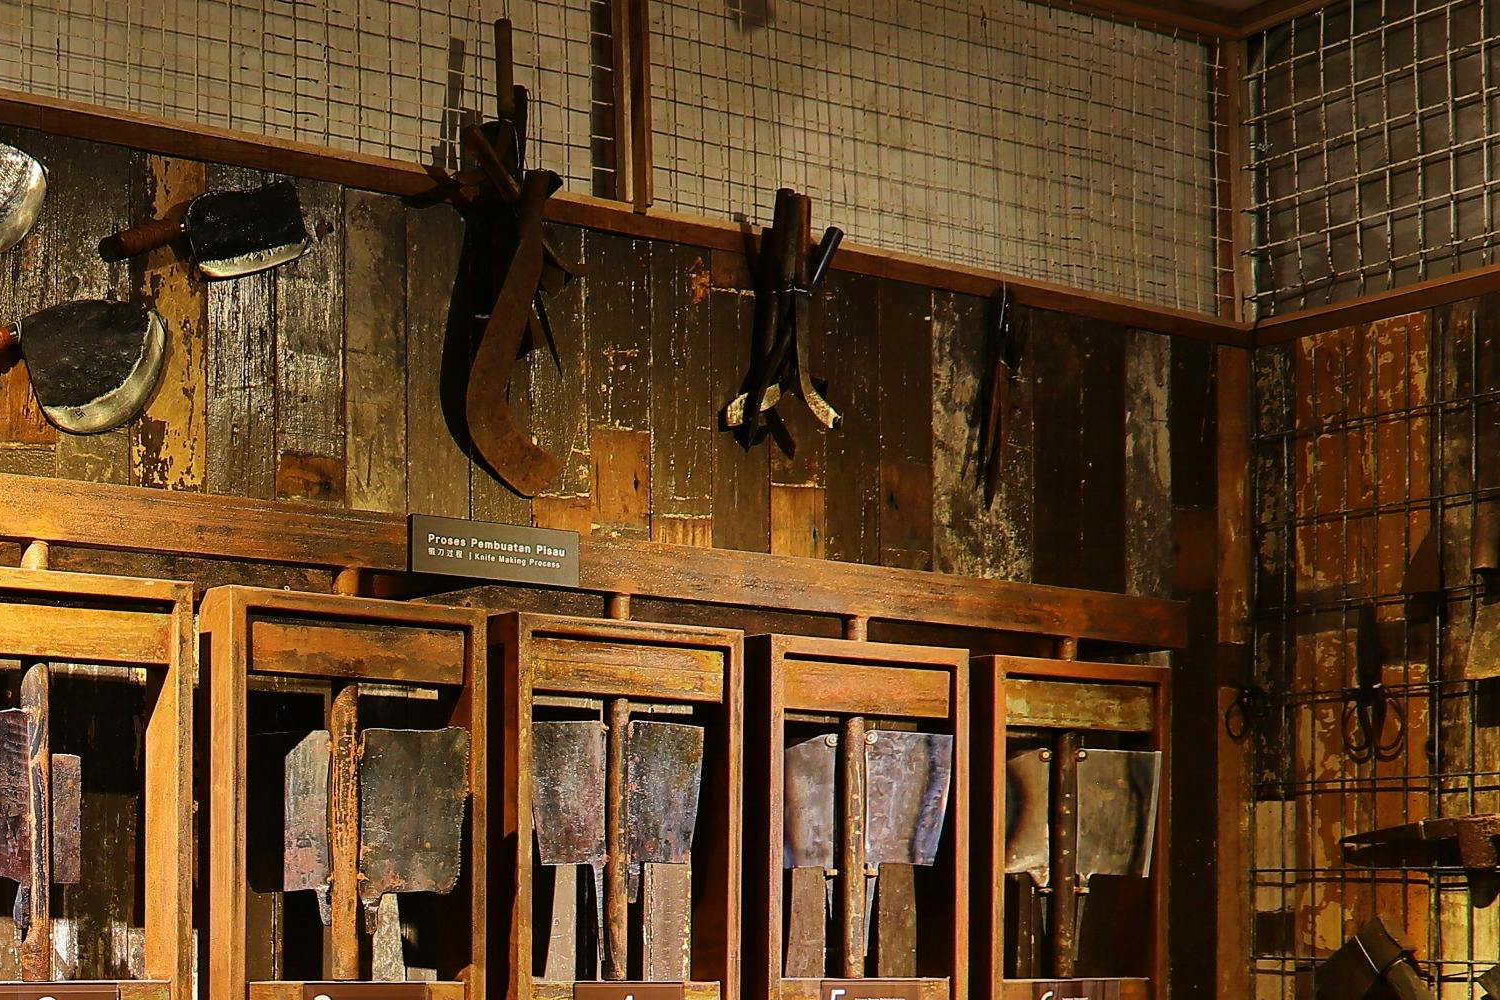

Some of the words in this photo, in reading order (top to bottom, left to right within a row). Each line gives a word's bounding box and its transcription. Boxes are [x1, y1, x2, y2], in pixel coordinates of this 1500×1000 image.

[428, 534, 466, 547] Proses
[471, 538, 531, 553] Pembuatan
[536, 545, 566, 557] Pisau
[475, 553, 495, 562] Knife
[498, 556, 526, 567] Making
[529, 559, 561, 569] Process
